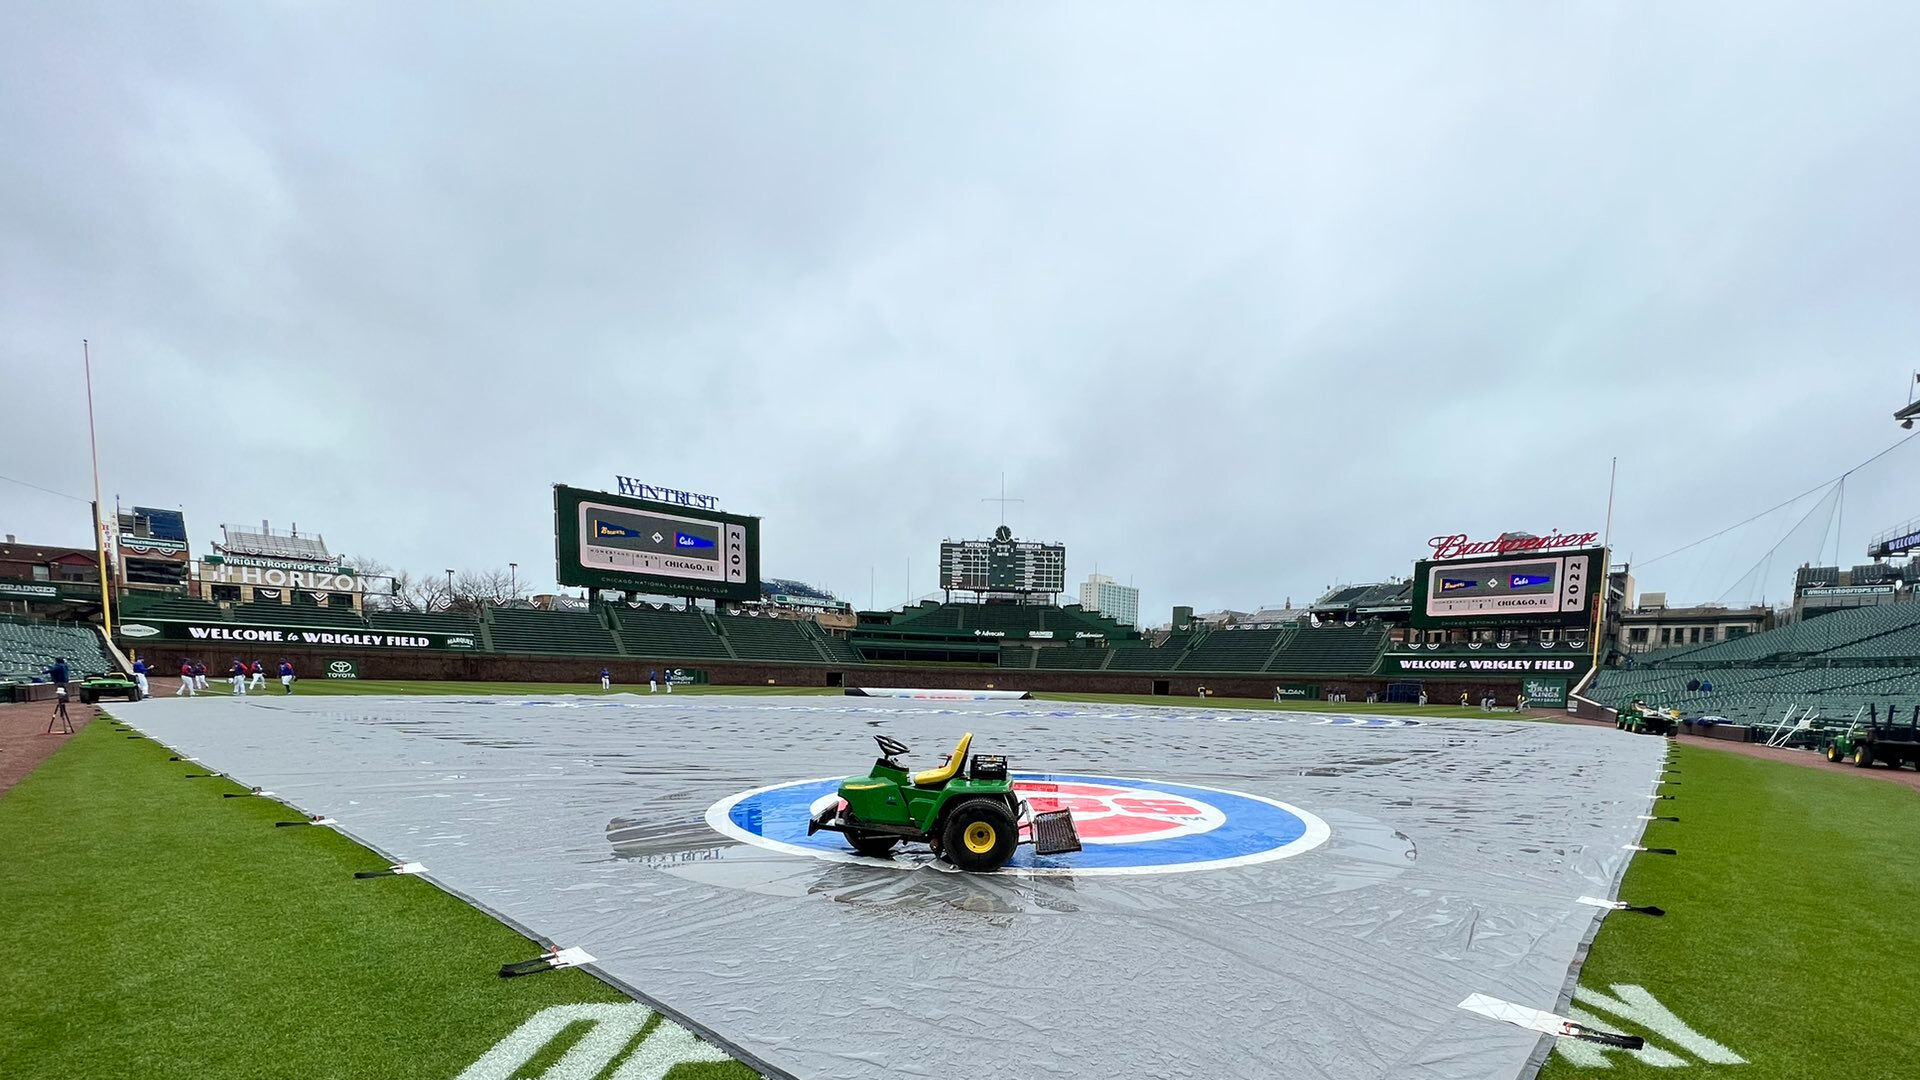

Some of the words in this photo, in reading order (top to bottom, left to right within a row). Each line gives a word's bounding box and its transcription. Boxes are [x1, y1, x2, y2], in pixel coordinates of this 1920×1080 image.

[616, 475, 719, 509] WINTRUST
[679, 536, 694, 546] Cubs
[1428, 528, 1598, 560] Budweiser
[731, 532, 741, 577] 2022
[665, 560, 705, 571] CHICAGO,
[0, 584, 57, 593] GRAINGER
[1567, 563, 1582, 606] 2022
[1498, 599, 1537, 607] CHICAGO,
[188, 627, 283, 641] WELCOME
[287, 633, 299, 641] to
[302, 632, 382, 645] WRIGLEY
[387, 636, 429, 647] FIELD
[1400, 661, 1457, 669] WELCOME
[1470, 661, 1532, 669] WRIGLEY
[1535, 661, 1574, 670] FIELD
